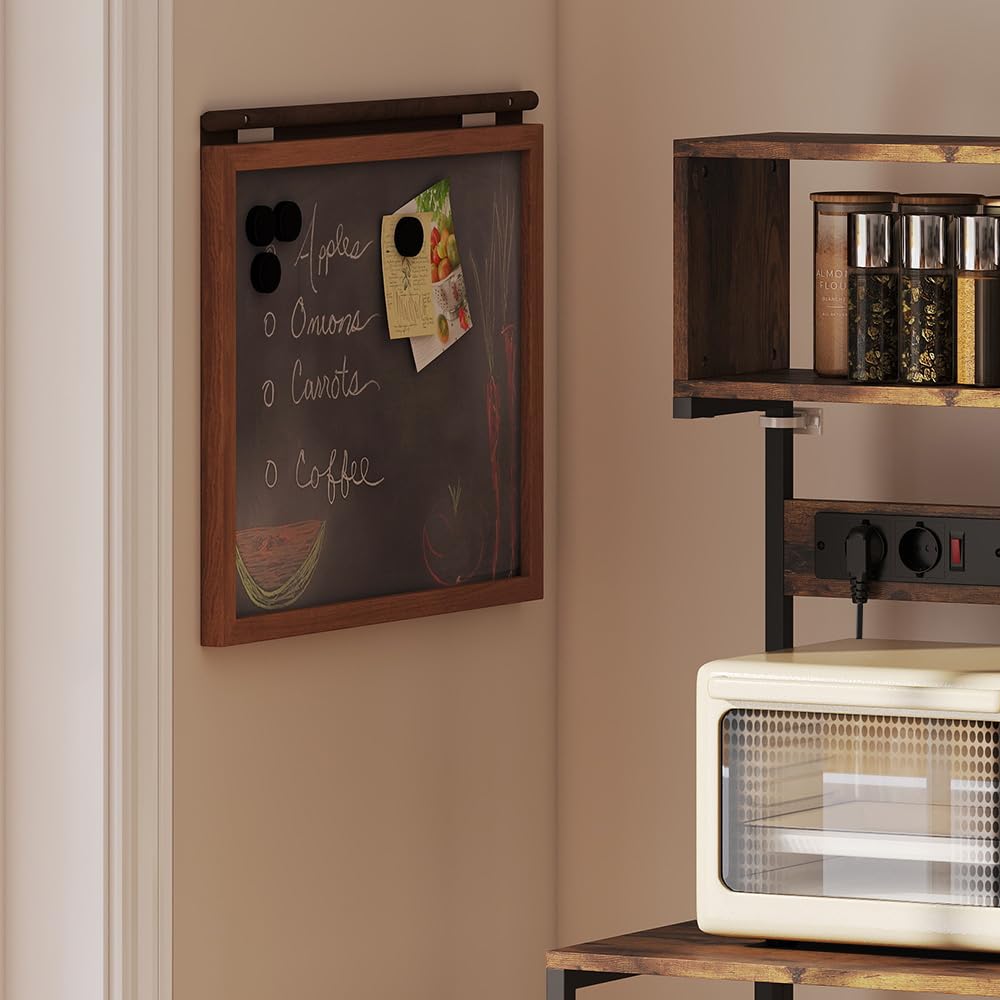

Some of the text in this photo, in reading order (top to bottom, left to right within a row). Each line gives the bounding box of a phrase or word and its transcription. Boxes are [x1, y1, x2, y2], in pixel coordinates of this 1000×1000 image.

[293, 200, 374, 293] Apples
[820, 280, 848, 290] FLOU
[291, 296, 380, 338] Onions
[291, 354, 381, 404] Carrots
[295, 449, 385, 504] Coffee
